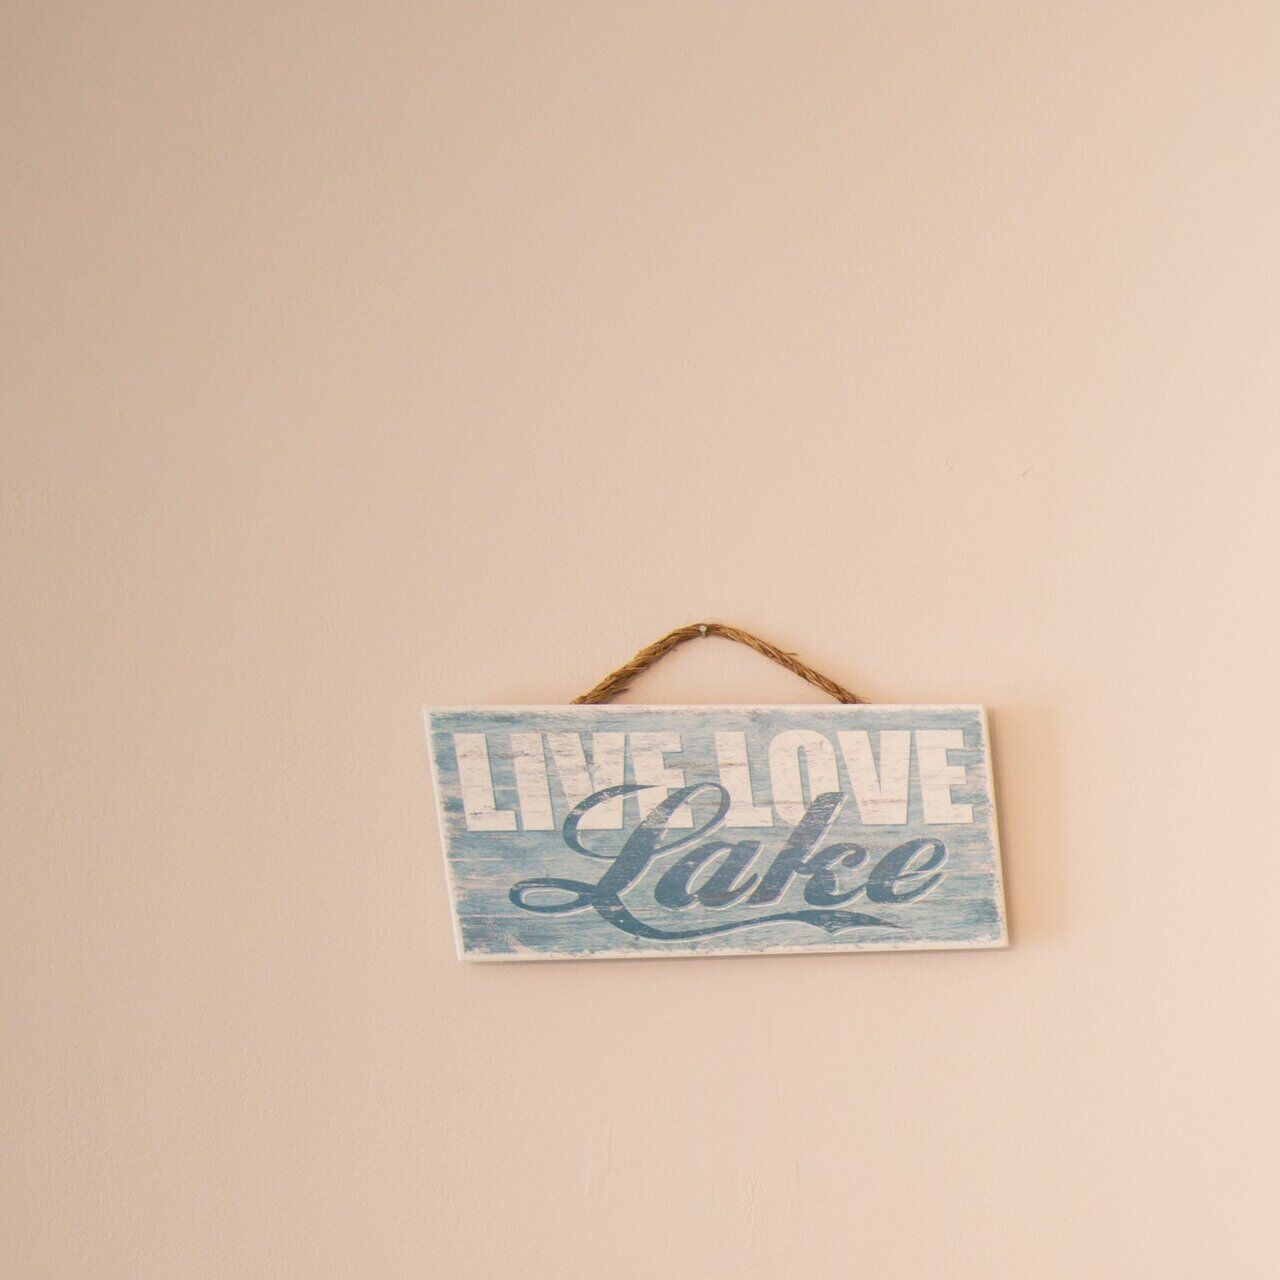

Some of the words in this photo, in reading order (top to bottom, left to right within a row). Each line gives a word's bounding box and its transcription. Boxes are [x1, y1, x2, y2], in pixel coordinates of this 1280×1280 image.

[453, 731, 694, 831] LIVE
[714, 729, 975, 828] LOVE
[509, 782, 949, 941] Lake
